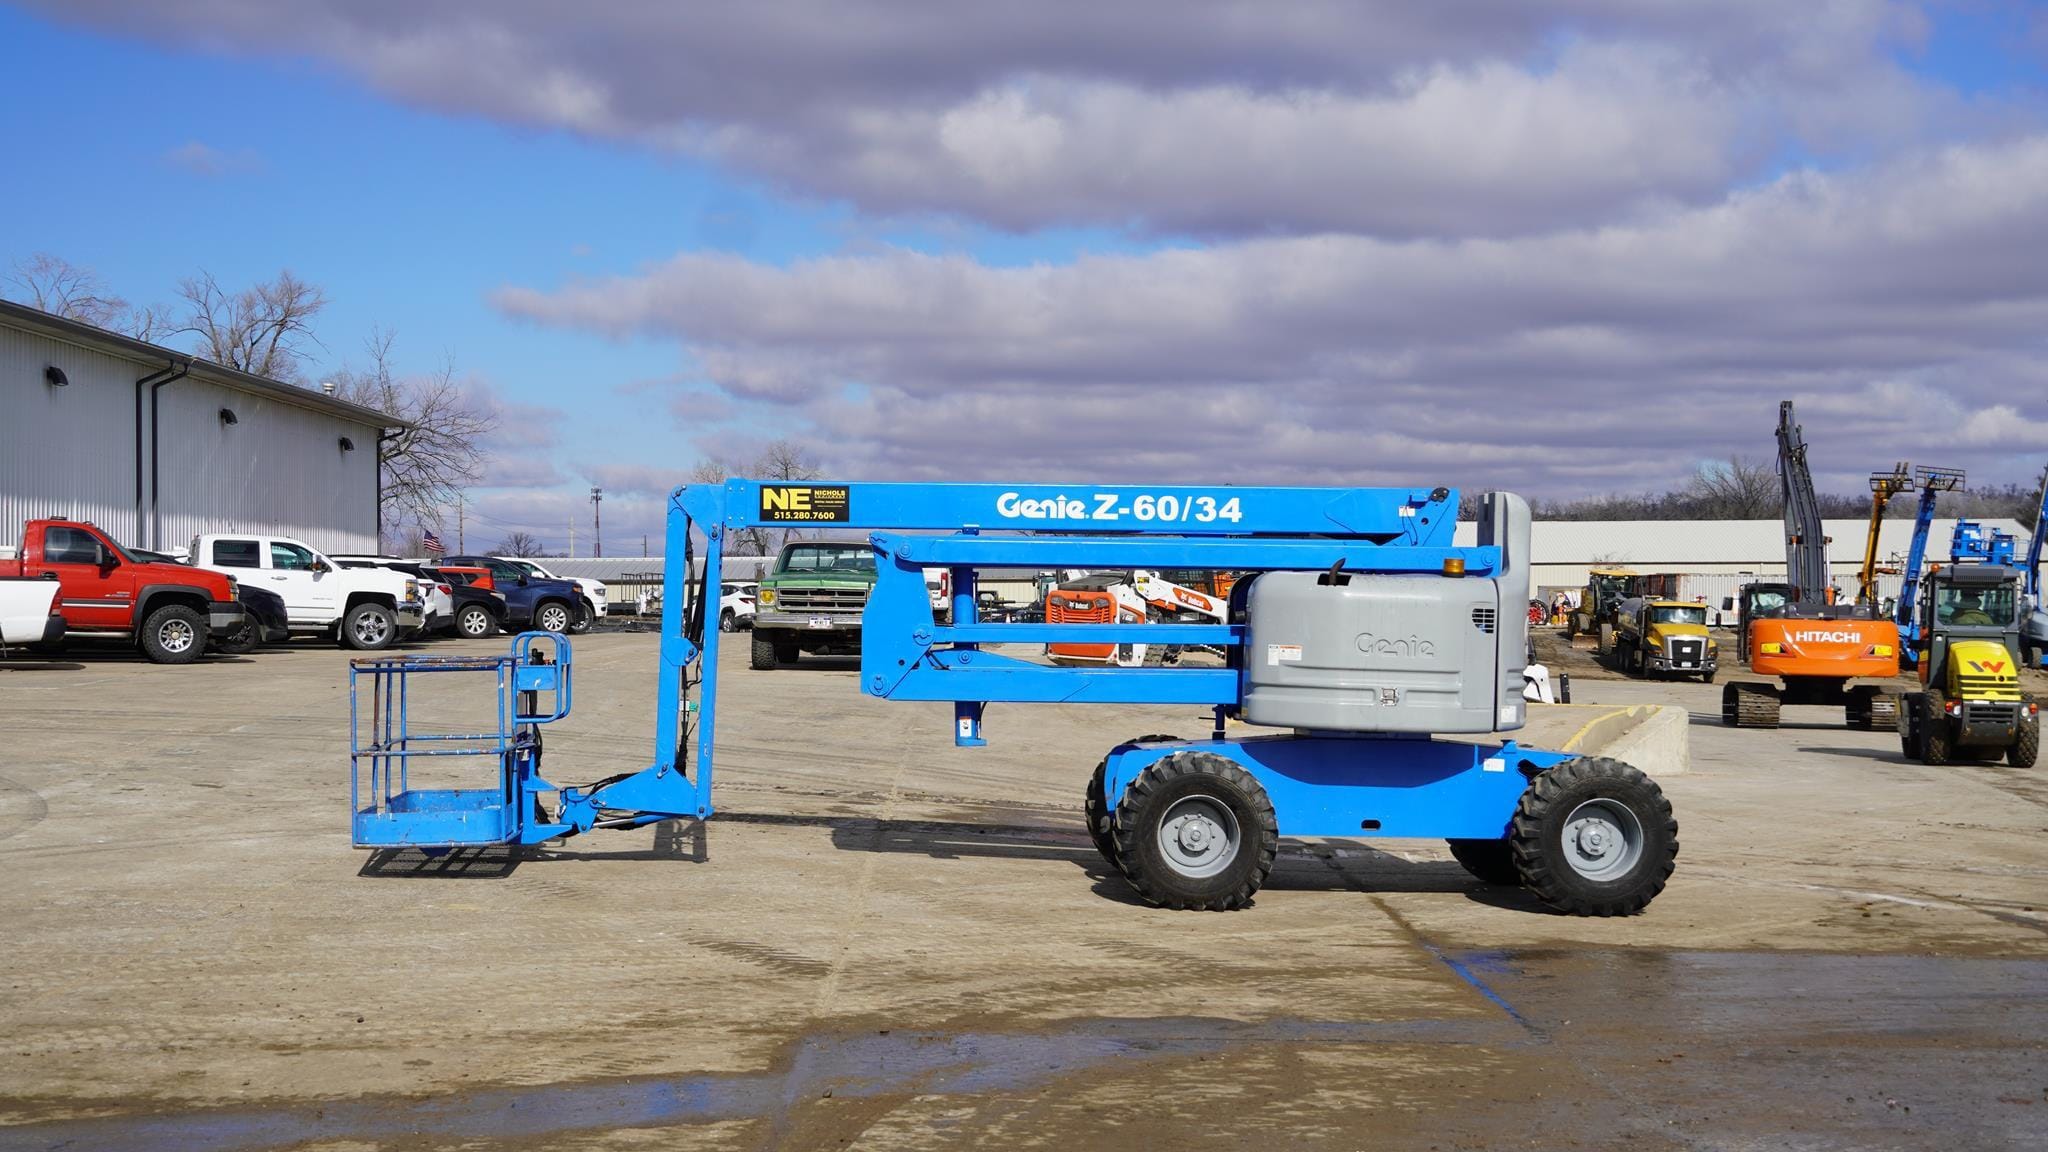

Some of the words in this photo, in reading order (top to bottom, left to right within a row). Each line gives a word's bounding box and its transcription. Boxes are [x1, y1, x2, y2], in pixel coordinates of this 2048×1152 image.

[763, 488, 811, 510] NE
[1092, 493, 1242, 523] Z-60/34
[774, 511, 835, 520] 515.280.7600
[1354, 632, 1435, 657] Genie
[1795, 631, 1861, 643] HITACHI
